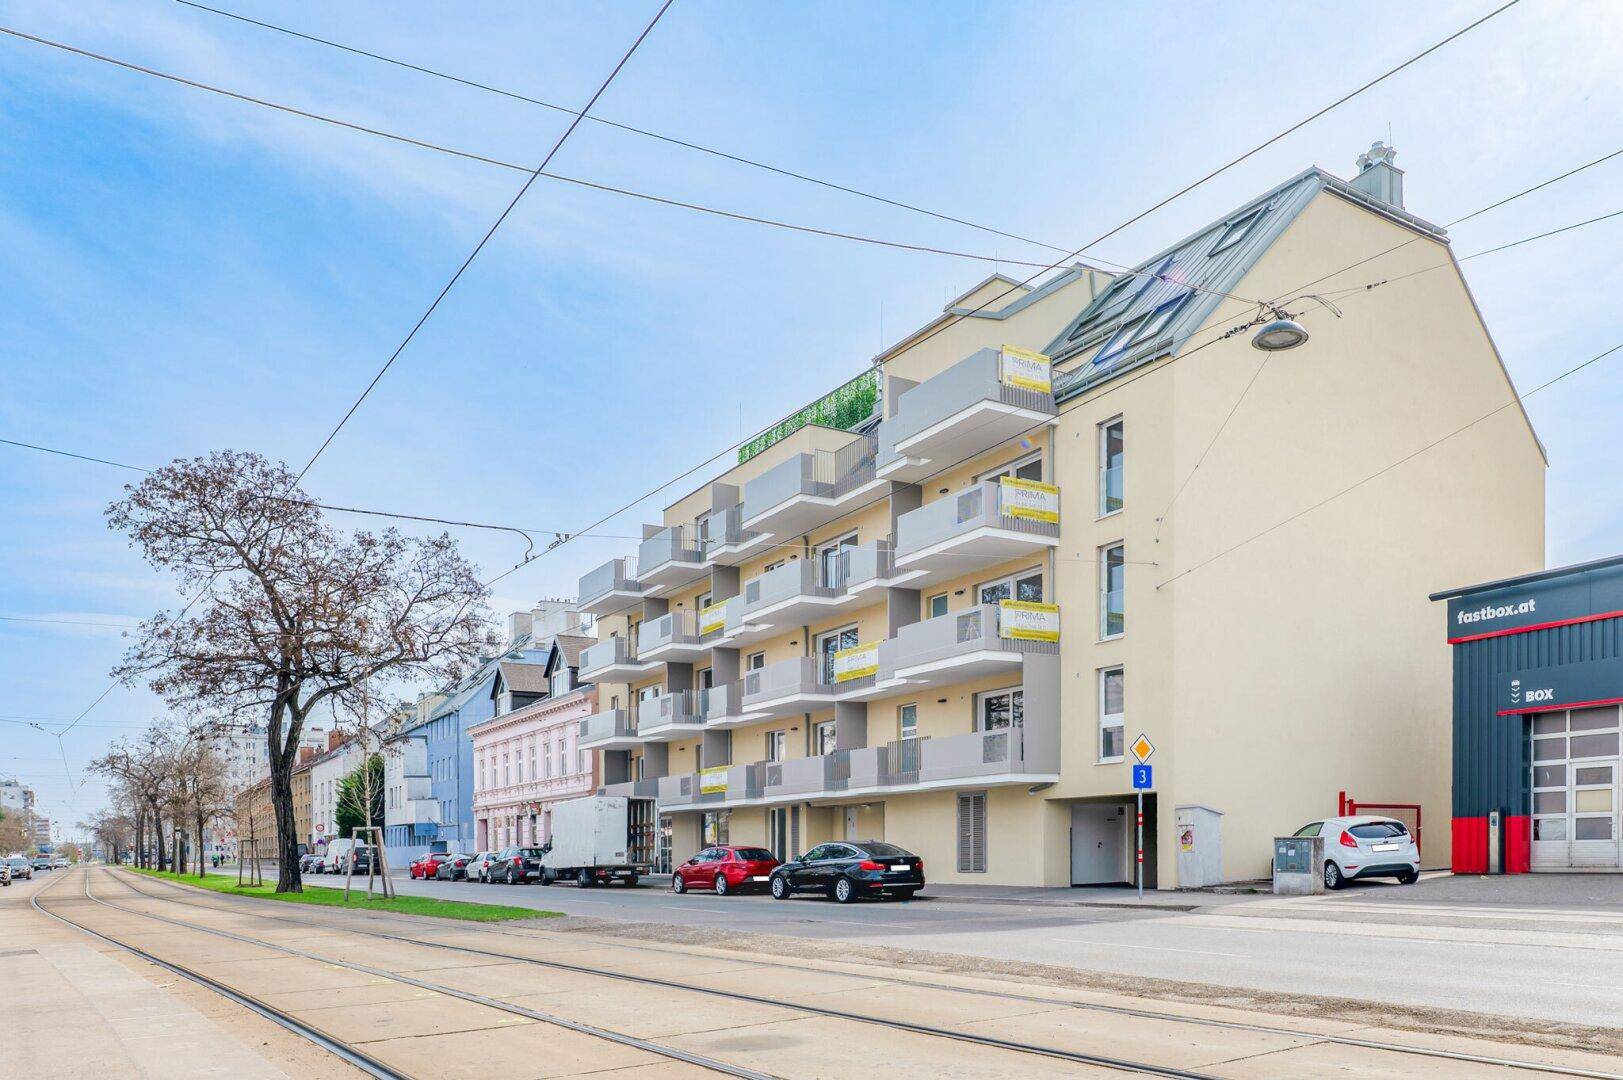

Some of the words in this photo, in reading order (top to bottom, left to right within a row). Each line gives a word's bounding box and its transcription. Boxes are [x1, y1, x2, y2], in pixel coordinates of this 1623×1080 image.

[1014, 610, 1047, 622] PRIMA
[1457, 599, 1536, 624] fastbox.at
[1525, 688, 1554, 702] BOX
[1139, 769, 1147, 784] 3
